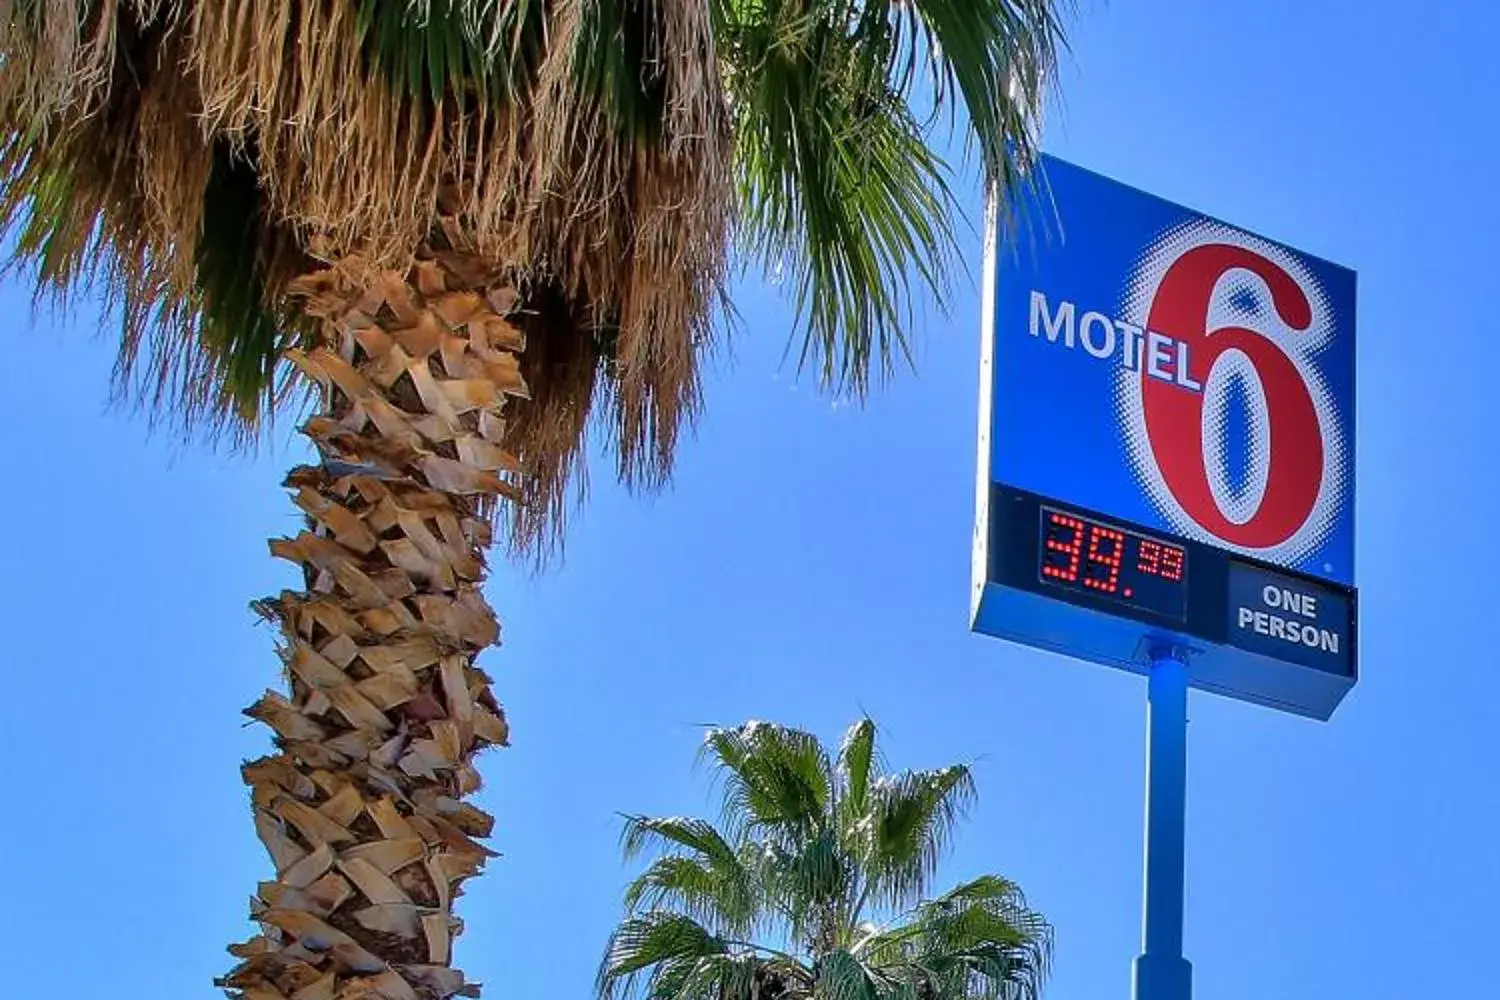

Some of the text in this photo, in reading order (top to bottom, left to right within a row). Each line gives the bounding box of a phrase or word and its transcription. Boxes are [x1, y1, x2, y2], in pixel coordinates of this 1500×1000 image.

[1029, 243, 1324, 549] MOTEL 6
[1263, 585, 1317, 619] ONE
[1238, 607, 1339, 654] PERSON
